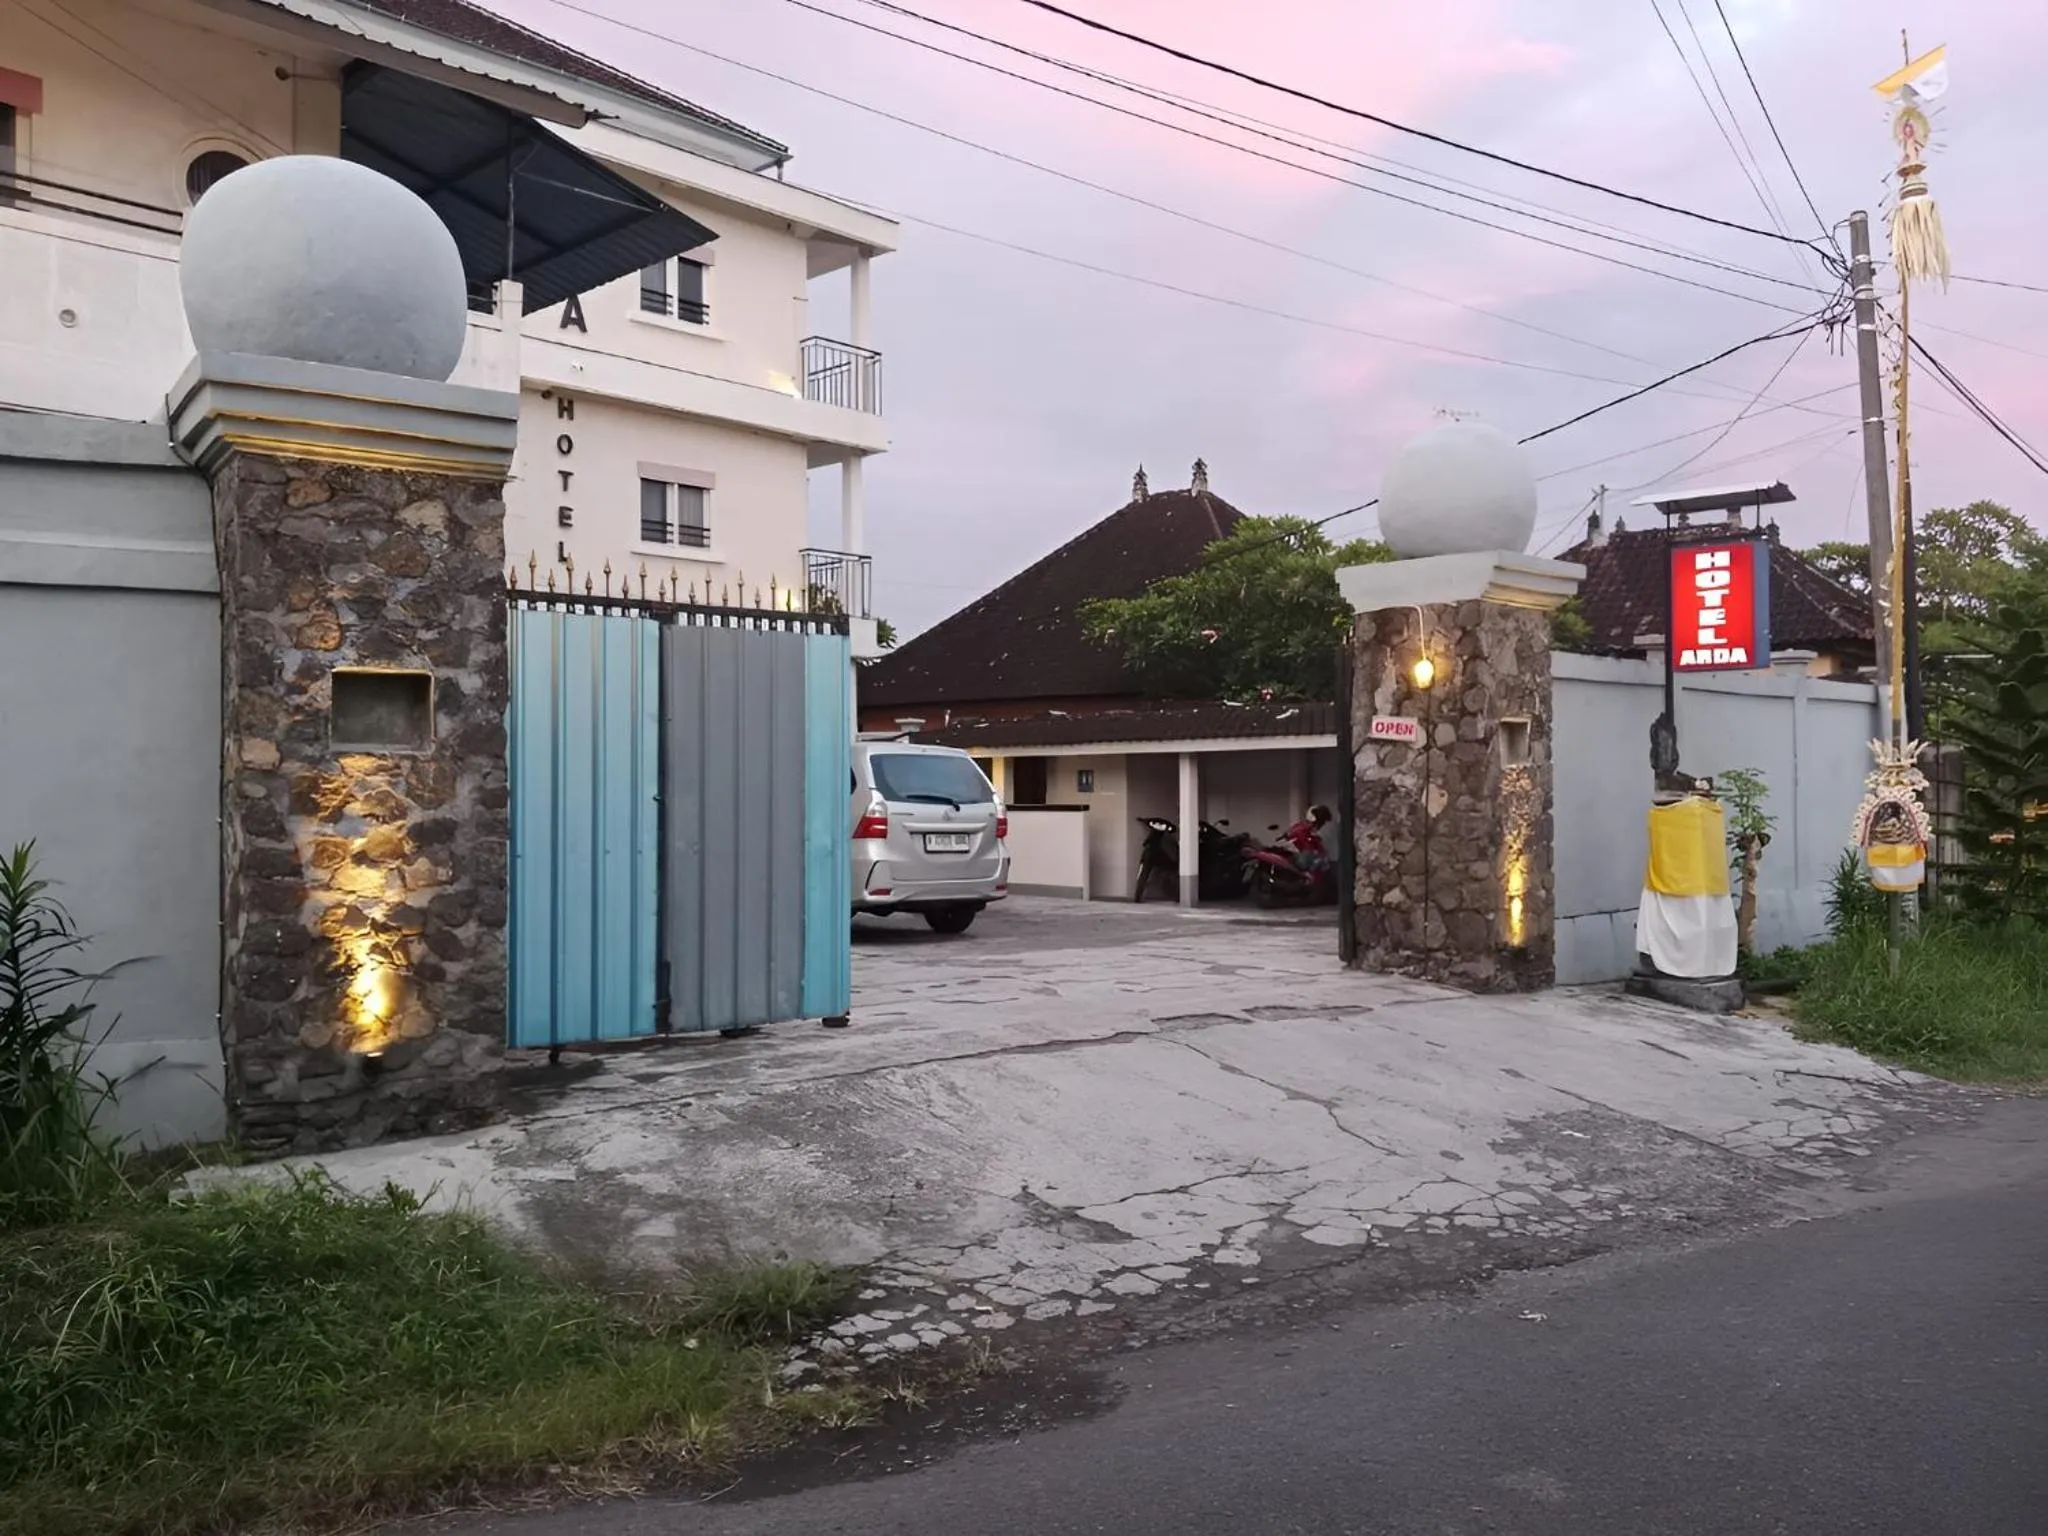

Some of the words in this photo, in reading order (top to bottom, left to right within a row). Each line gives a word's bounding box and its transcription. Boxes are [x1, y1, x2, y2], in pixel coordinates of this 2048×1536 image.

[556, 397, 575, 563] HOTEL
[1695, 550, 1731, 645] HOTEL
[1680, 647, 1748, 666] ARDA
[1375, 722, 1414, 736] OPEN
